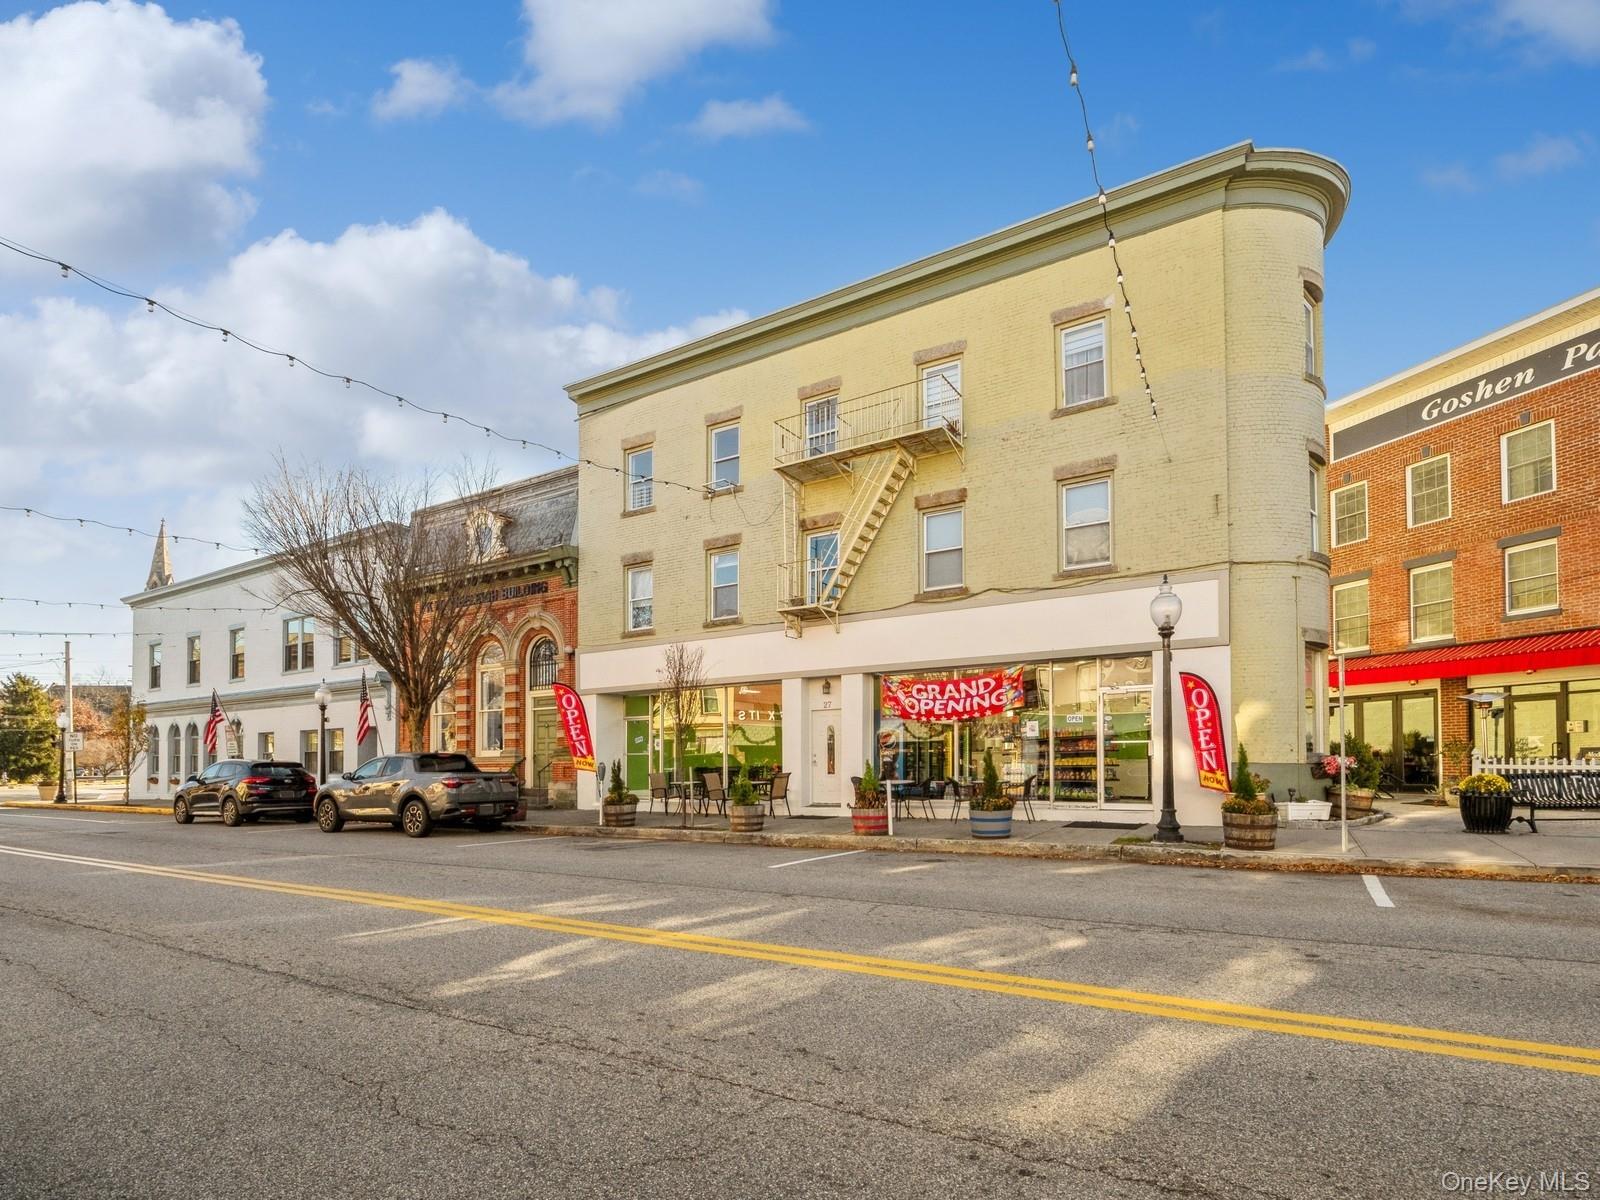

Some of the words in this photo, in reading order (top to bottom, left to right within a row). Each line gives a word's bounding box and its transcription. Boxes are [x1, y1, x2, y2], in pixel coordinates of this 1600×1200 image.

[1421, 367, 1535, 421] Goshen
[911, 677, 996, 700] GRAND
[823, 701, 832, 709] 27
[902, 688, 1009, 715] OPENING
[562, 694, 588, 757] OPEN
[1191, 688, 1217, 771] OPEN
[576, 759, 594, 768] NOW
[1203, 775, 1224, 786] NOW
